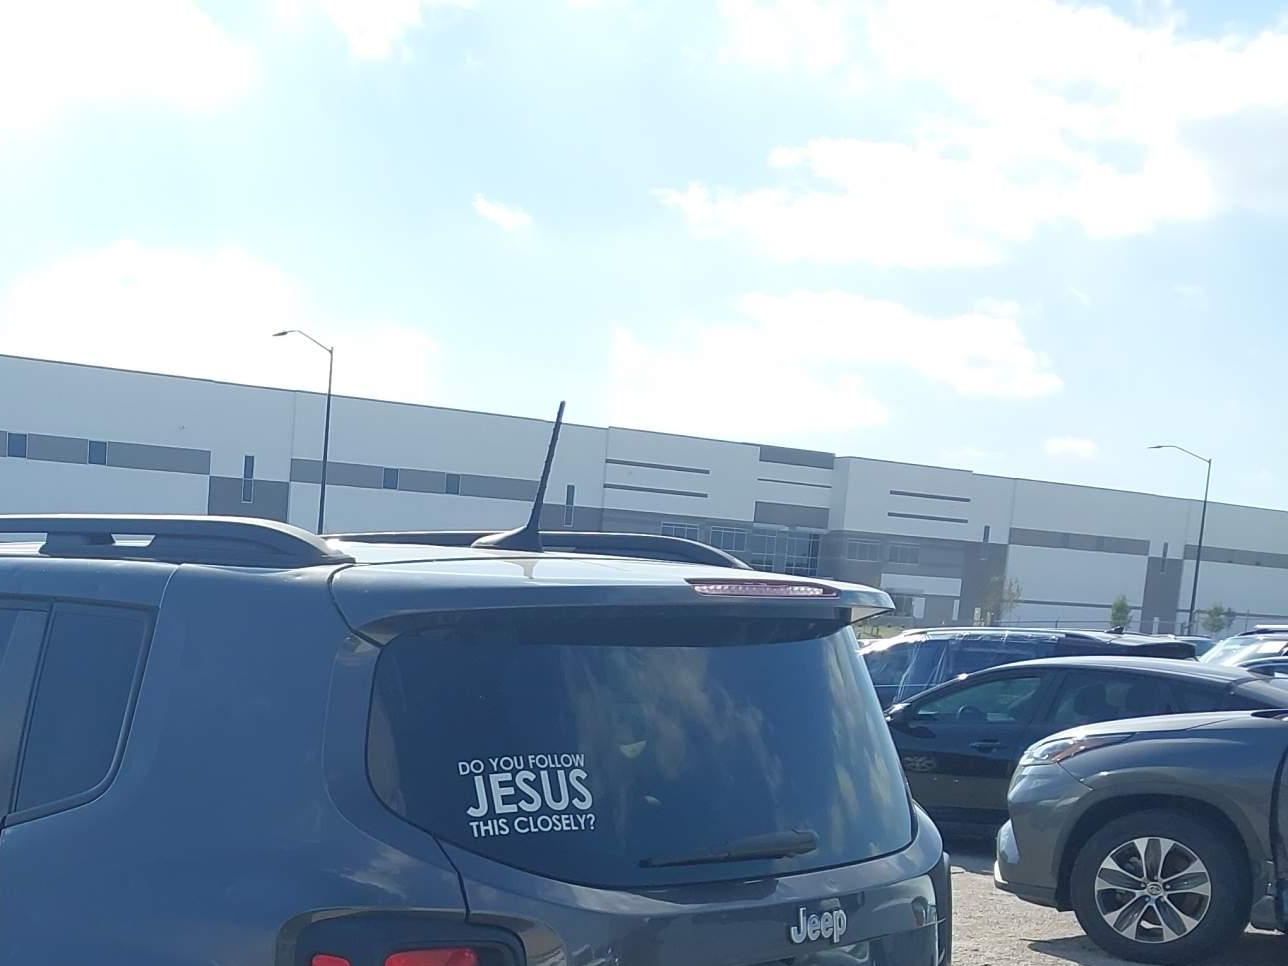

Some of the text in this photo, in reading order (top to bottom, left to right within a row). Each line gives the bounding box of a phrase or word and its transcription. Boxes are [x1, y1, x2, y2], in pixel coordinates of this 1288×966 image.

[458, 753, 585, 775] DO YOU FOLLOW
[466, 768, 593, 817] JESUS
[469, 813, 596, 837] THIS CLOSELY?
[790, 907, 847, 944] Jeep
